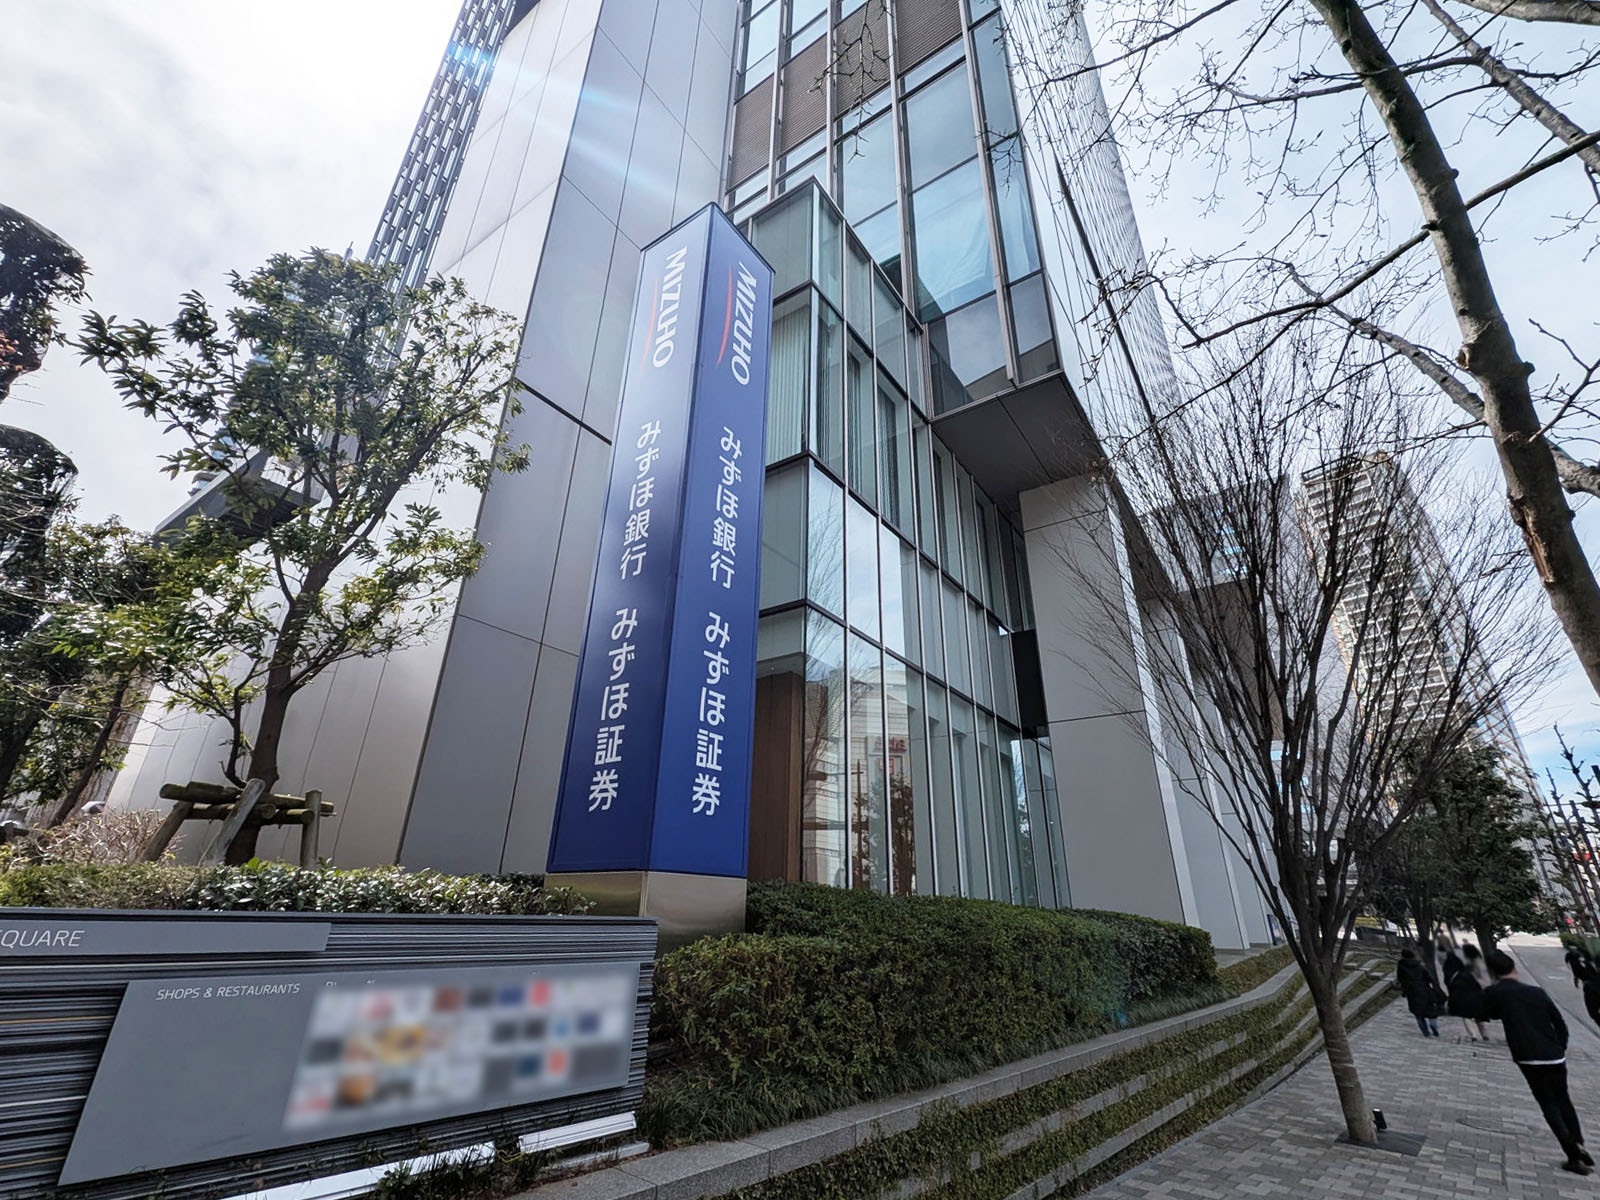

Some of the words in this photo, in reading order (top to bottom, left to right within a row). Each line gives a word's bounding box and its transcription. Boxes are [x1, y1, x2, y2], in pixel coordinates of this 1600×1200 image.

[653, 245, 688, 368] MIZUHO
[731, 261, 757, 385] MIZUHO
[620, 420, 661, 580] みずほ銀行
[710, 426, 742, 589] みずほ銀行
[588, 608, 638, 812] みずほ証券
[692, 611, 730, 816] みずほ証券
[0, 929, 85, 949] QUARE
[156, 988, 200, 1000] SHOPS
[203, 987, 213, 998] &
[216, 983, 300, 998] RESTAURANTS
